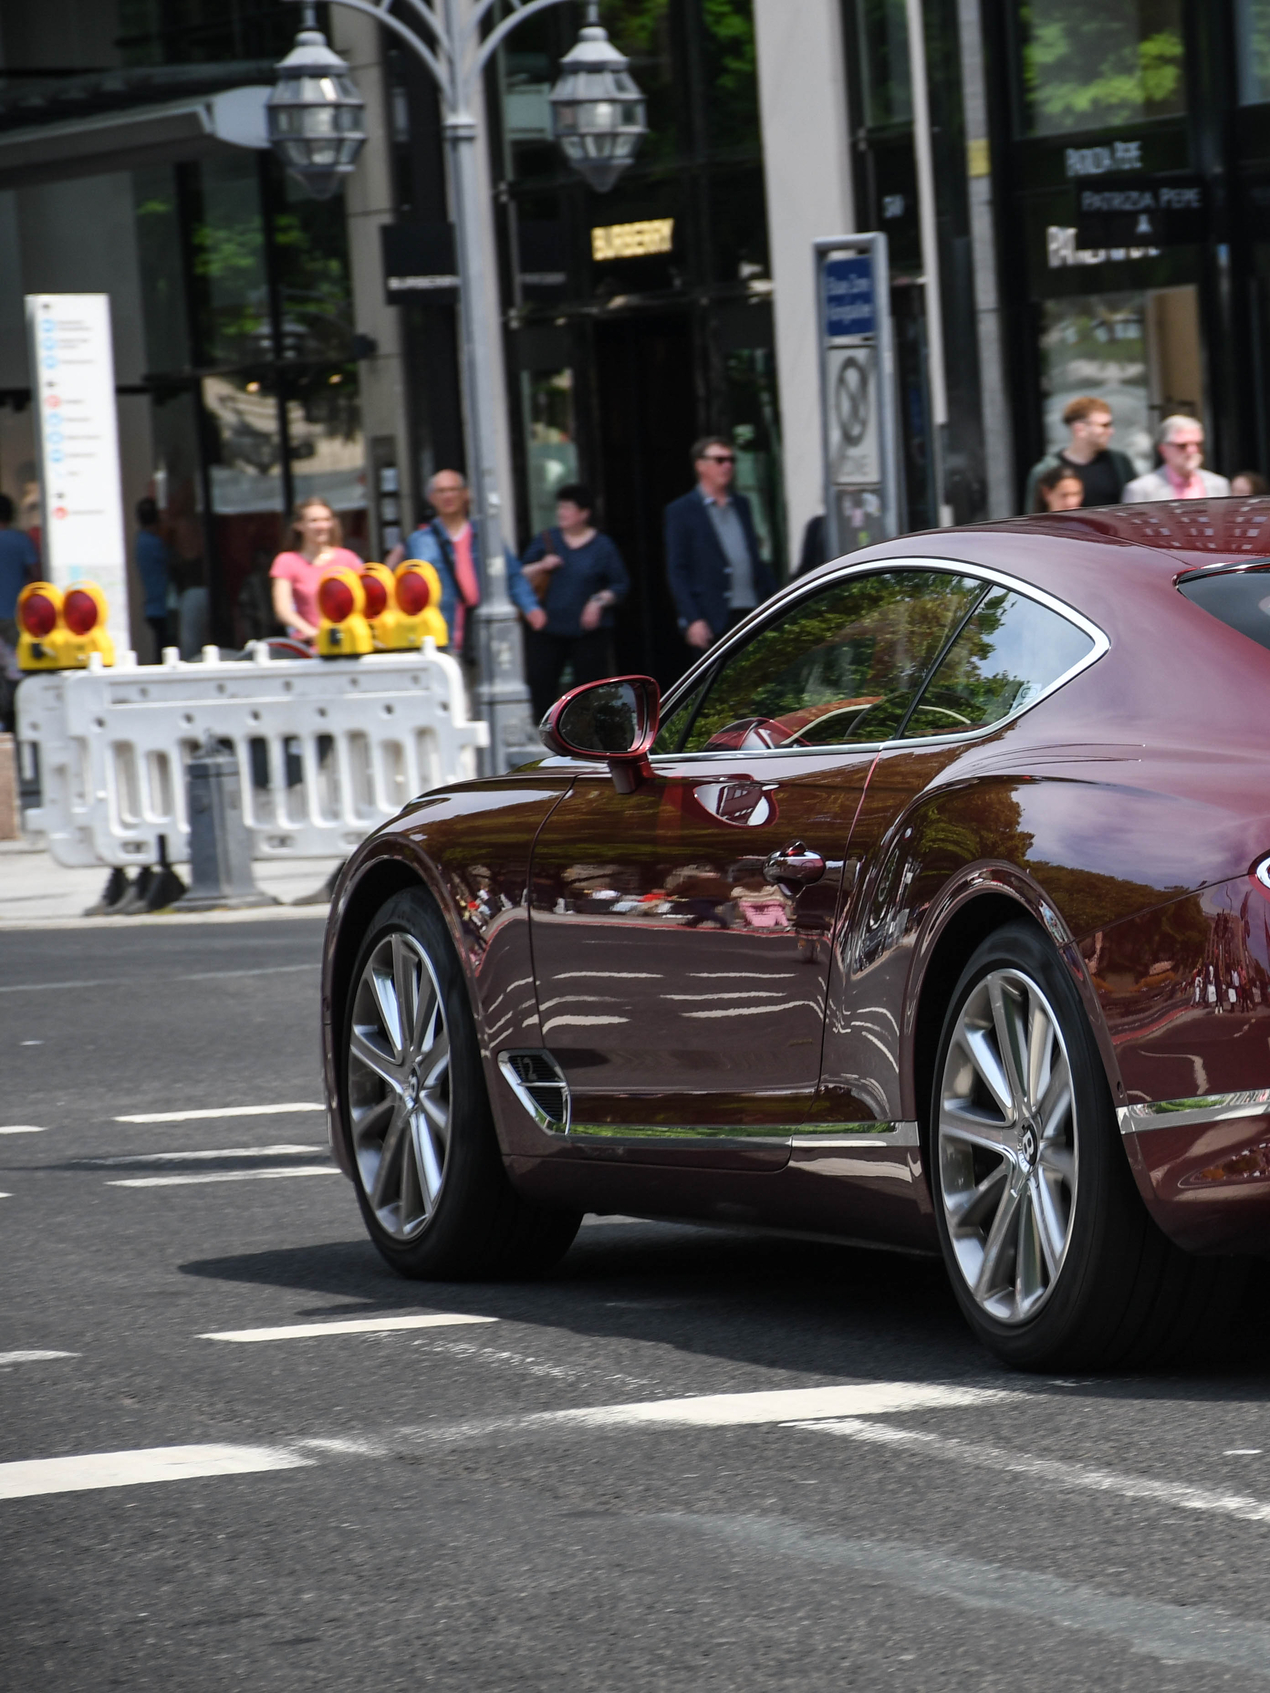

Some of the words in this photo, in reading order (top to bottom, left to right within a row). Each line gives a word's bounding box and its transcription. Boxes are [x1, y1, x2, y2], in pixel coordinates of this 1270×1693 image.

[1080, 190, 1155, 211] PATRIZIA
[1158, 187, 1201, 209] PEPE
[591, 217, 674, 261] BURBERRY
